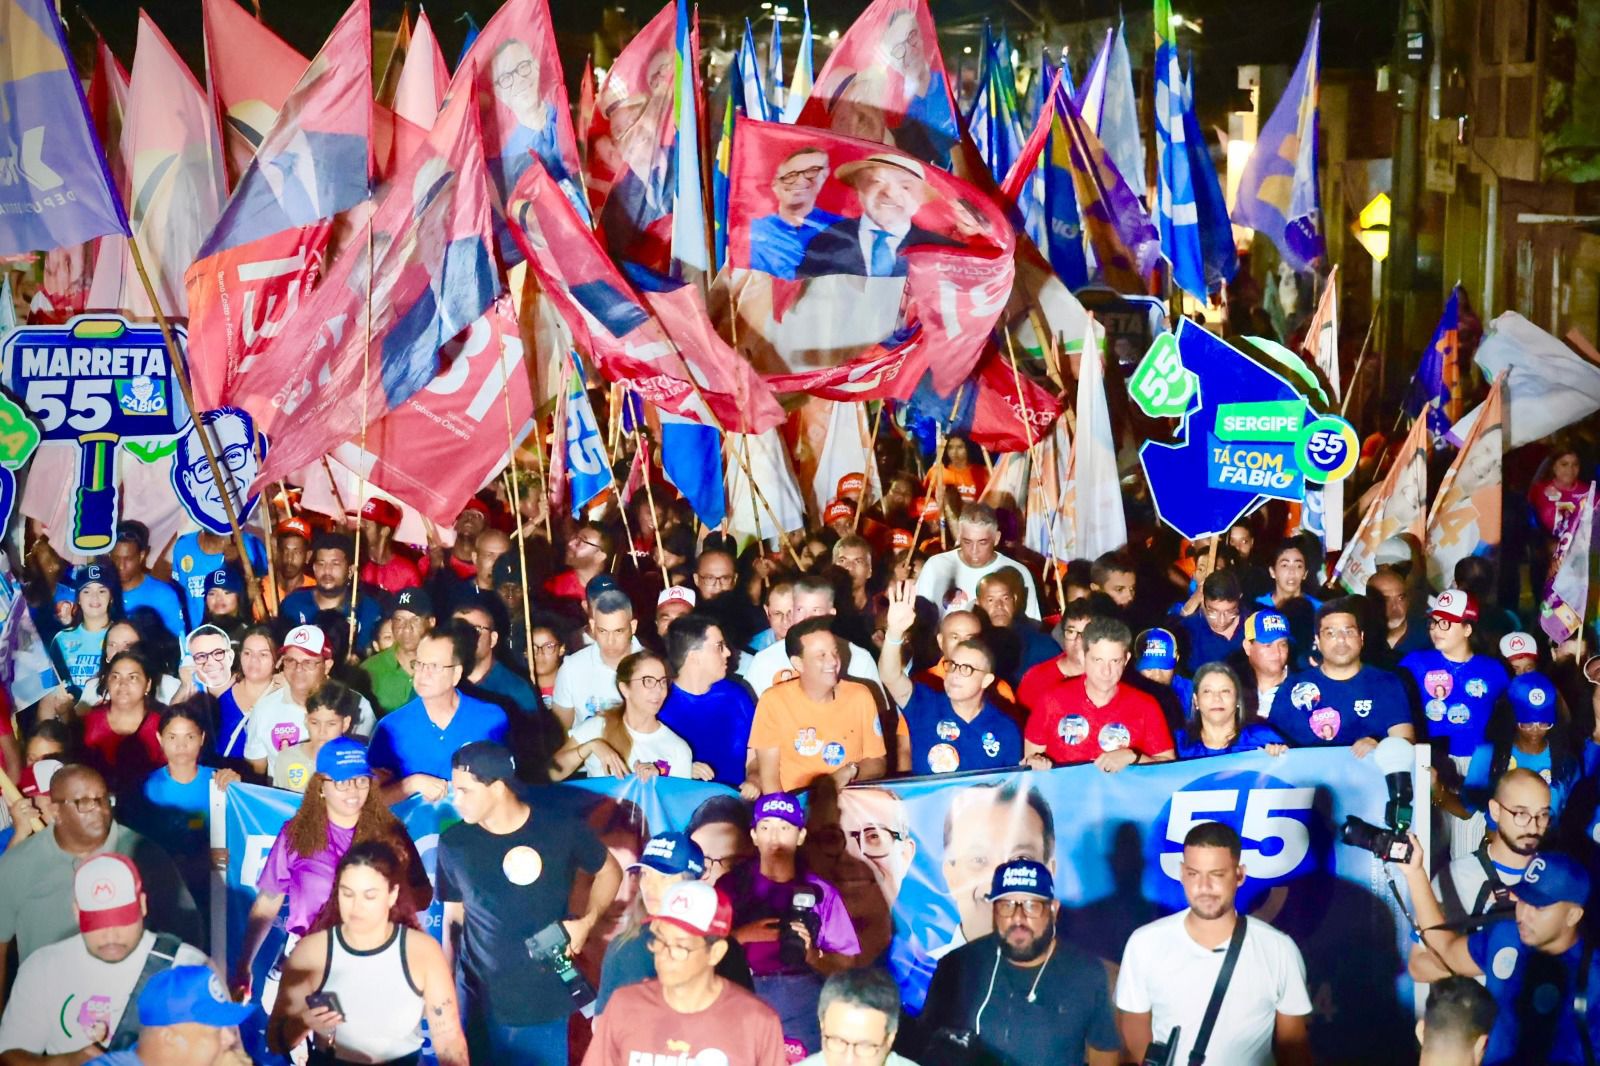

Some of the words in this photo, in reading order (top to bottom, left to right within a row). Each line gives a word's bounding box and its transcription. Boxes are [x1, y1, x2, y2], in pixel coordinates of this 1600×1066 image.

[21, 348, 166, 378] MARRETA
[1139, 343, 1184, 408] 55
[25, 379, 113, 432] 55
[1223, 415, 1298, 432] SERGIPE
[1308, 431, 1347, 455] 55
[1213, 445, 1231, 465] TÁ
[1233, 450, 1284, 473] COM
[88, 565, 100, 579] C
[213, 570, 226, 585] C
[670, 587, 684, 599] M
[1439, 594, 1452, 604] M
[294, 630, 309, 643] M
[1510, 638, 1525, 648] M
[1354, 699, 1373, 712] 55
[274, 726, 296, 735] 5505
[288, 768, 304, 779] 55
[762, 799, 795, 814] 5505
[1160, 787, 1316, 880] 55
[1523, 857, 1546, 884] C
[93, 882, 113, 896] M
